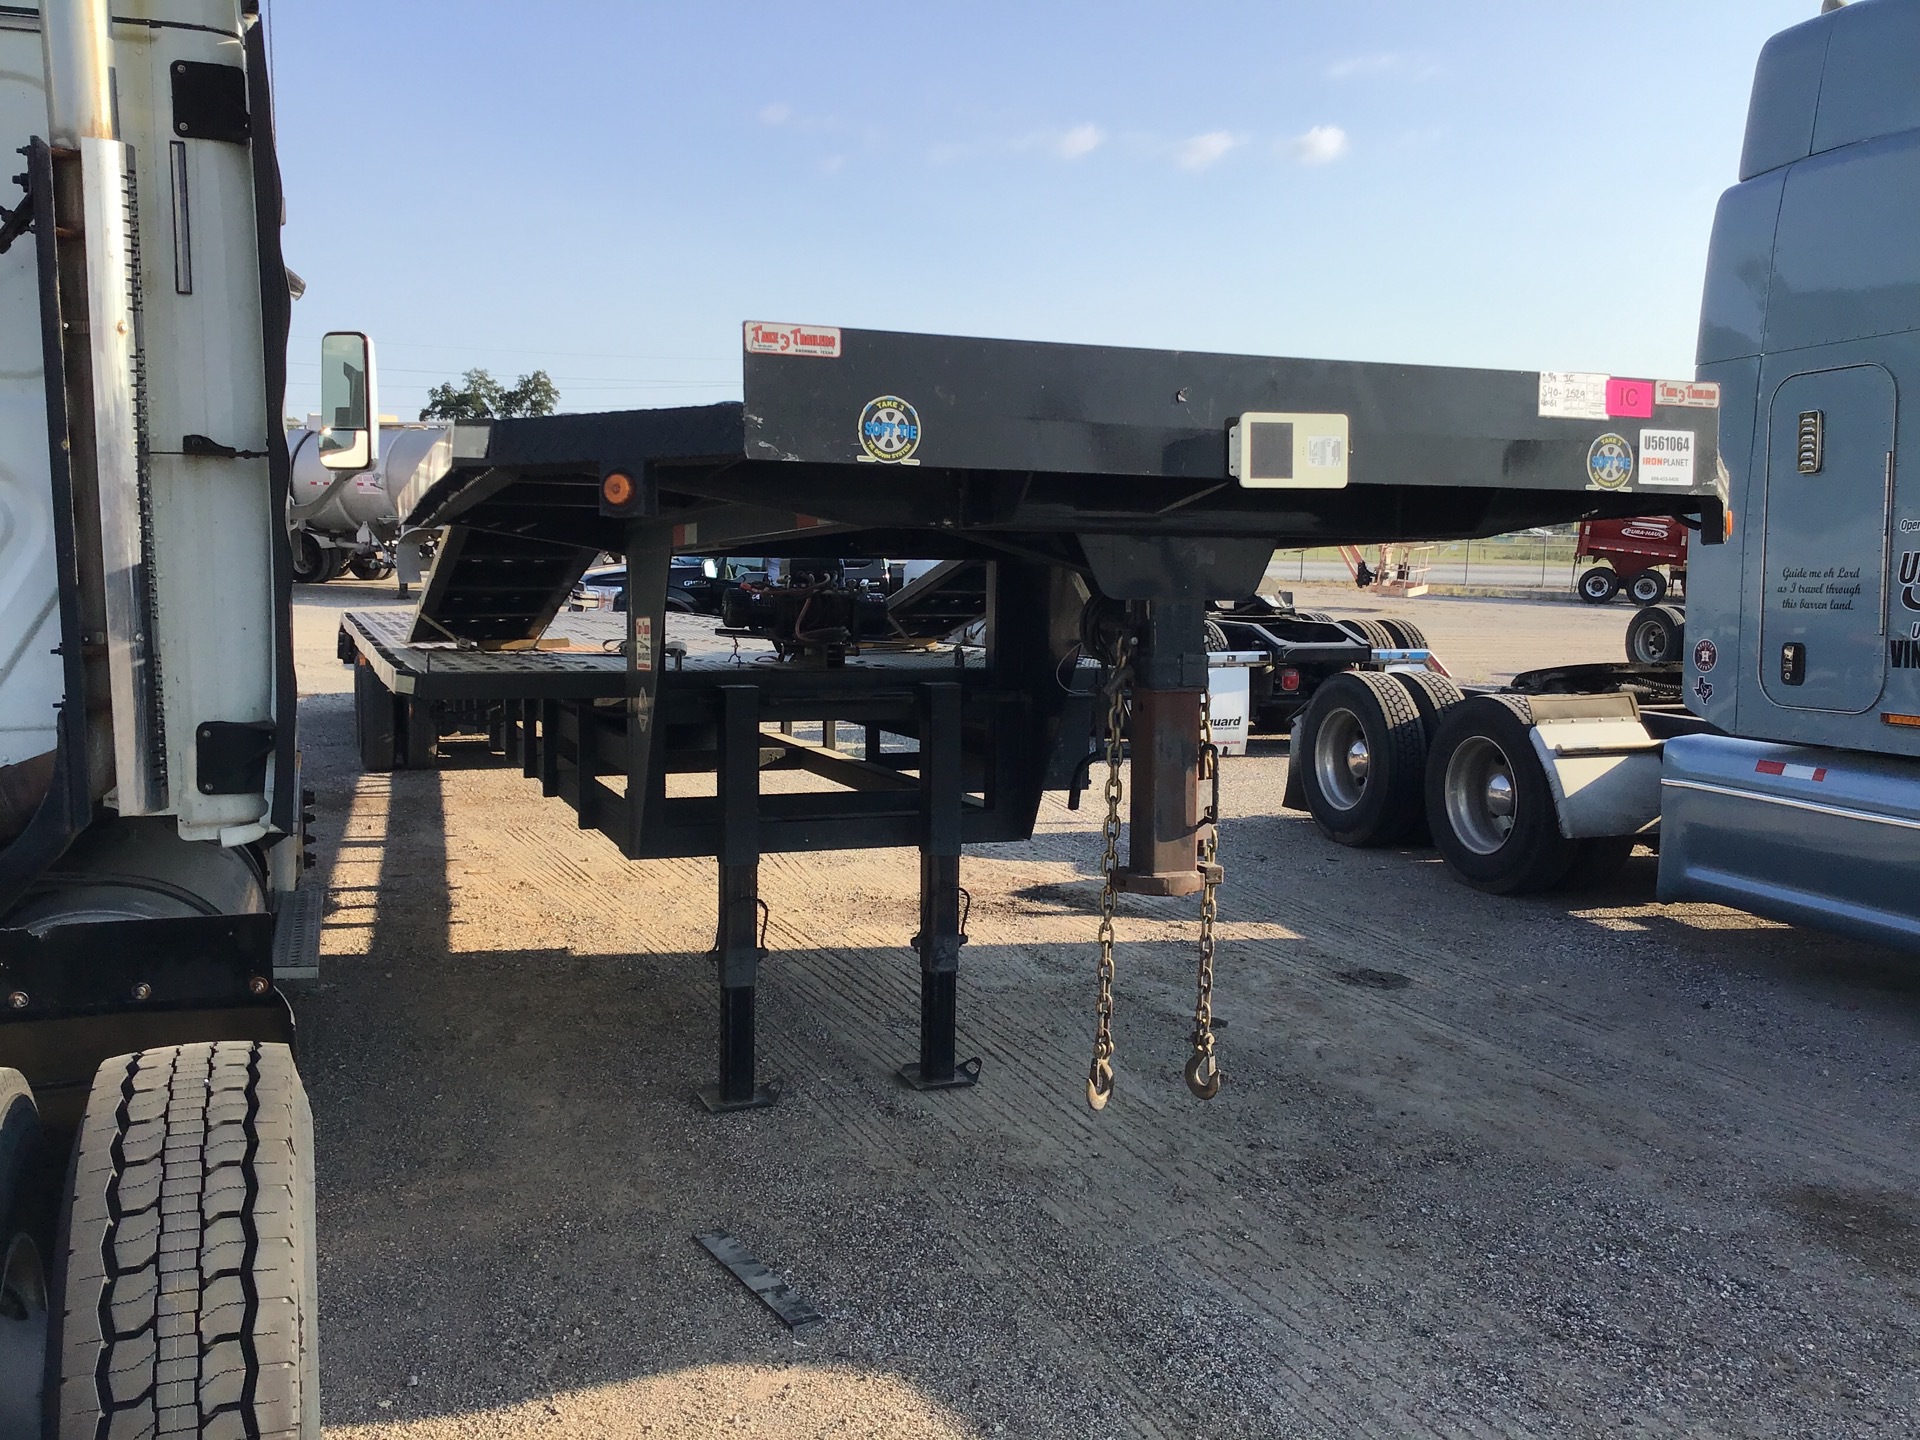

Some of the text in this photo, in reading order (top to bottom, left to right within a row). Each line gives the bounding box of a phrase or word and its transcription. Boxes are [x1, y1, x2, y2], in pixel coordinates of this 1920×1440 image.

[780, 333, 790, 351] 3
[790, 328, 836, 349] TRAILERS
[1620, 387, 1638, 407] IC
[1678, 389, 1685, 403] 3
[877, 401, 898, 409] TAKE
[865, 421, 917, 439] SOFT TIE
[867, 439, 911, 459] TIE DOWN SYSTEM
[1644, 435, 1690, 452] U561064
[1592, 455, 1630, 469] SOFT TIE
[1626, 529, 1662, 537] DURA-HAUL
[1782, 566, 1807, 580] Guide
[1823, 567, 1834, 578] oh
[1836, 566, 1860, 578] Lord
[1900, 552, 1920, 585] U
[1789, 582, 1797, 593] I
[1798, 583, 1824, 594] travel
[1825, 583, 1861, 597] through
[1782, 598, 1854, 610] this barren land.
[1701, 650, 1710, 662] H
